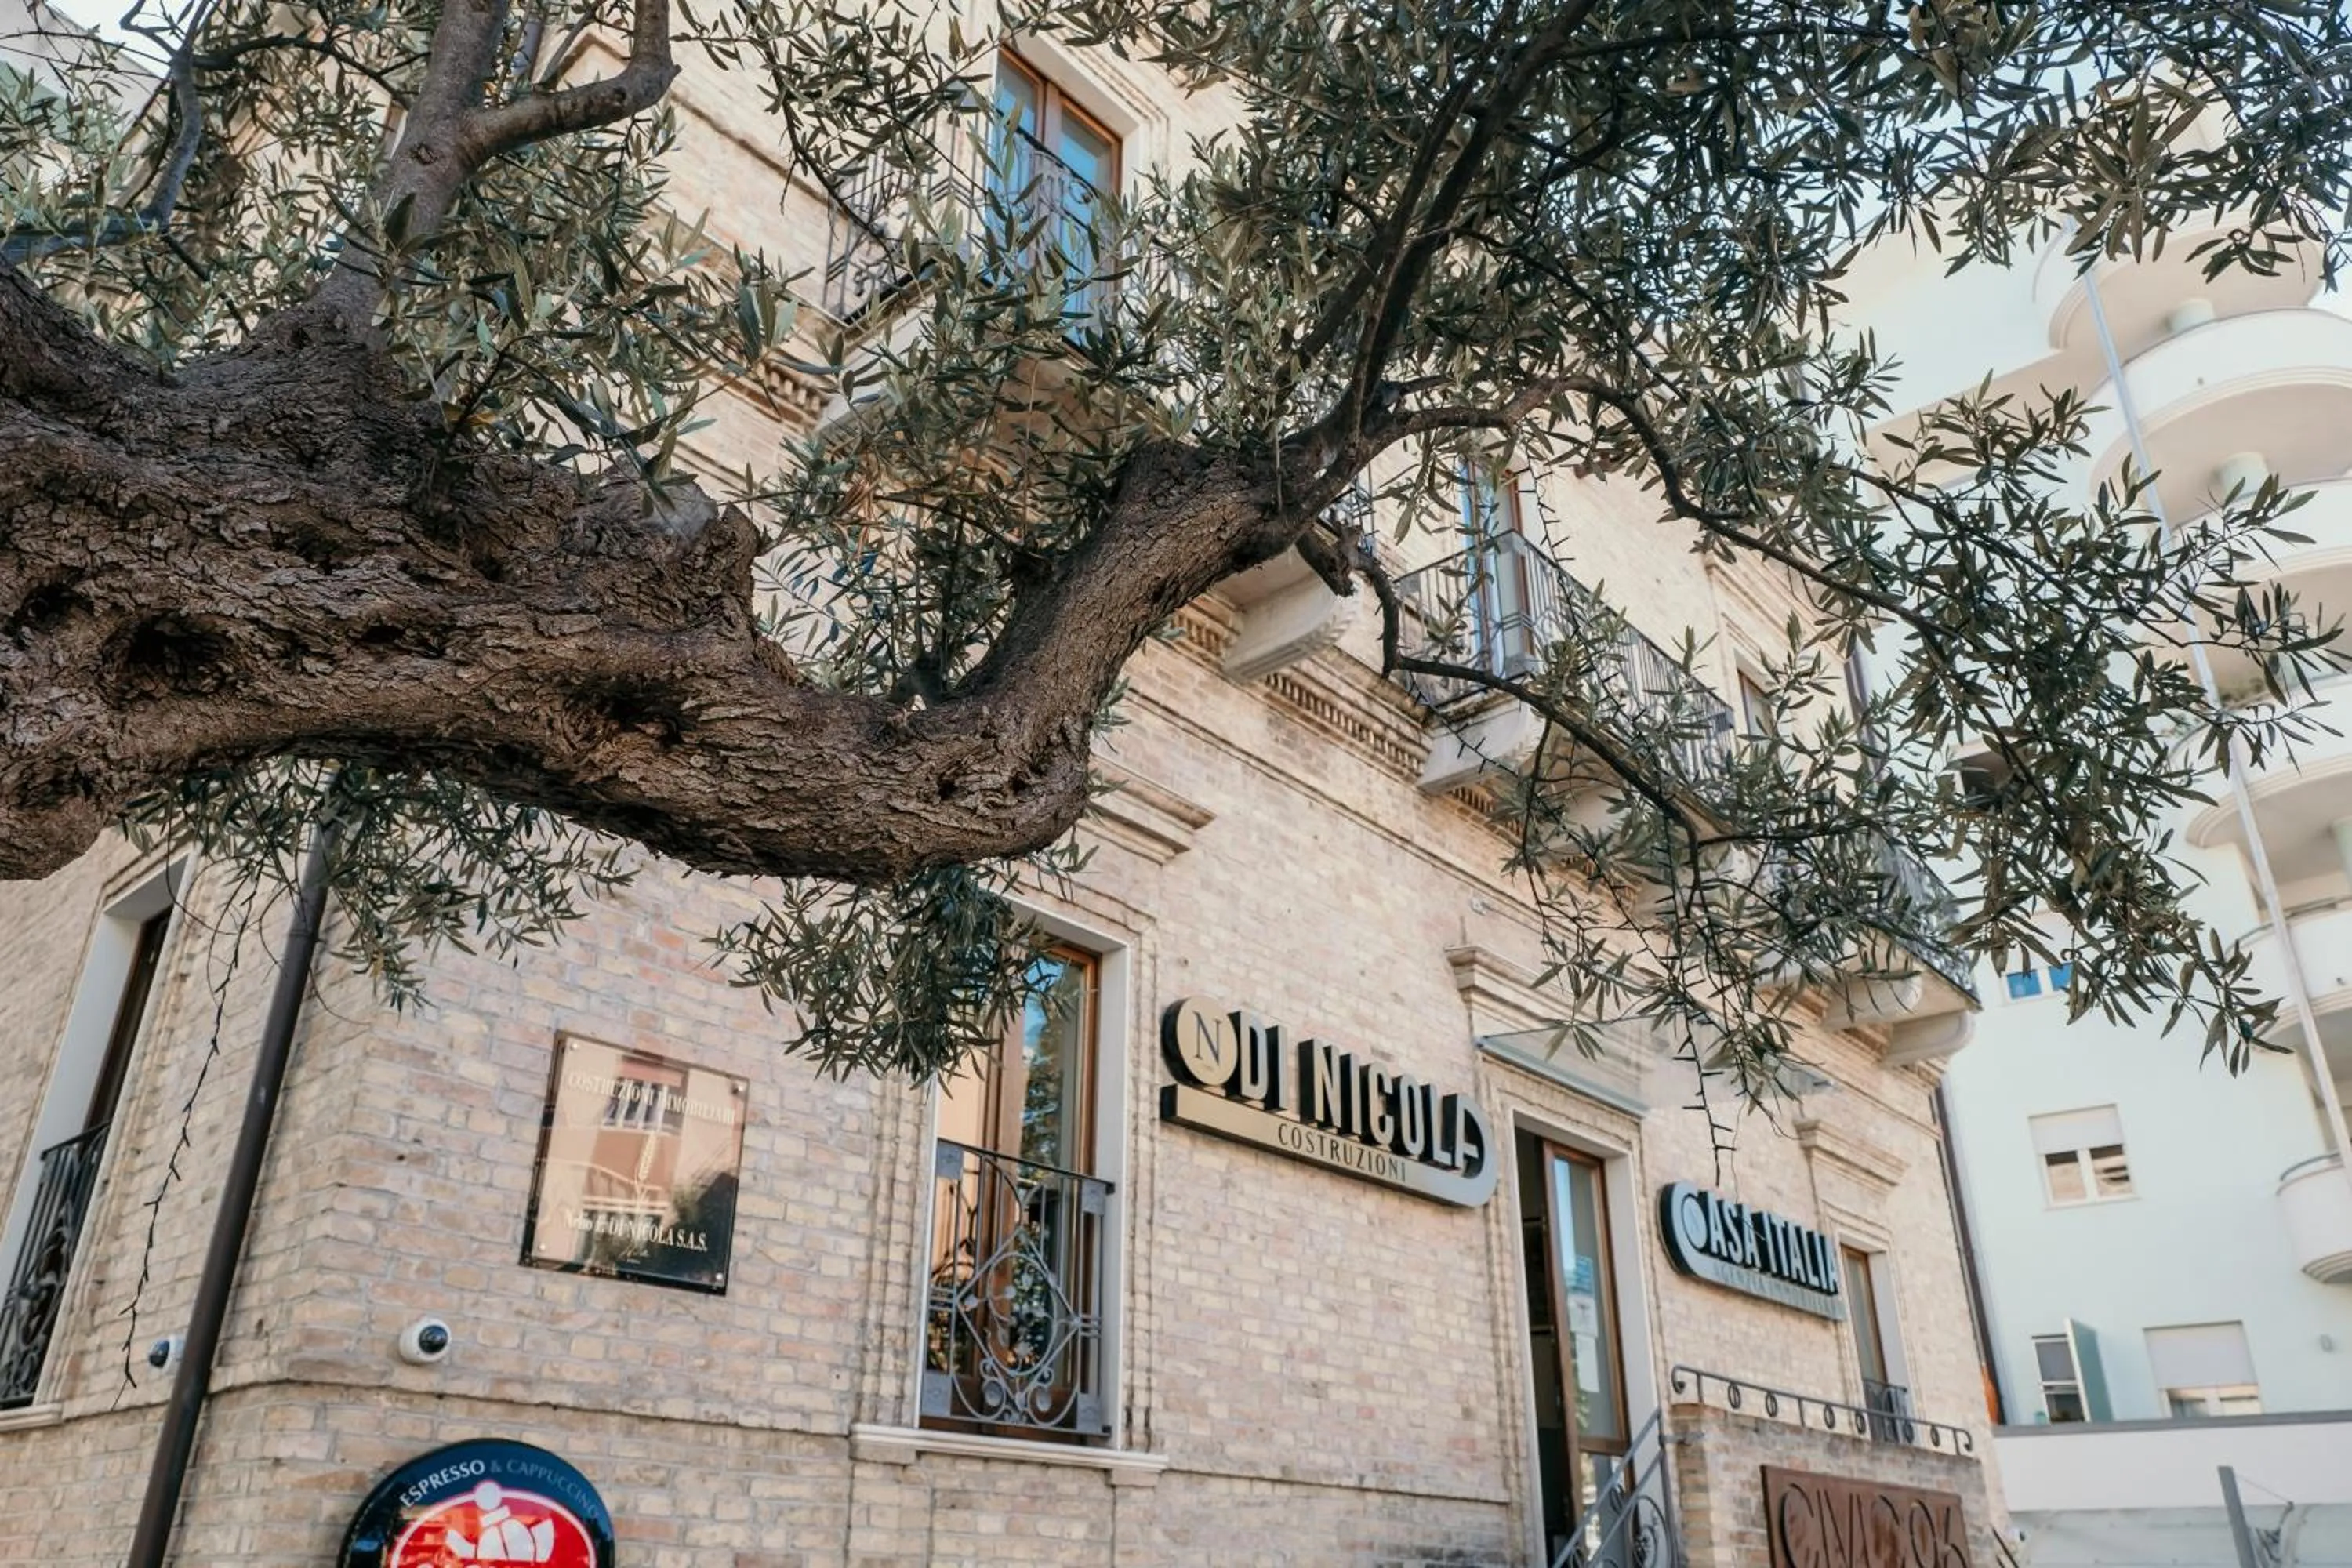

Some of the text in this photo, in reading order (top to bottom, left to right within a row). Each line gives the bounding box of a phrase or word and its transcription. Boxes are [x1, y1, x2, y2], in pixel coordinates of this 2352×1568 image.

[1191, 1010, 1224, 1066] N
[1233, 1011, 1494, 1178] DI NICOLA
[1277, 1122, 1407, 1183] COSTRUZIONI
[1668, 1178, 1838, 1294] CASA ITALIA
[399, 1459, 601, 1519] ESPRESSO & CAPPUCCINO
